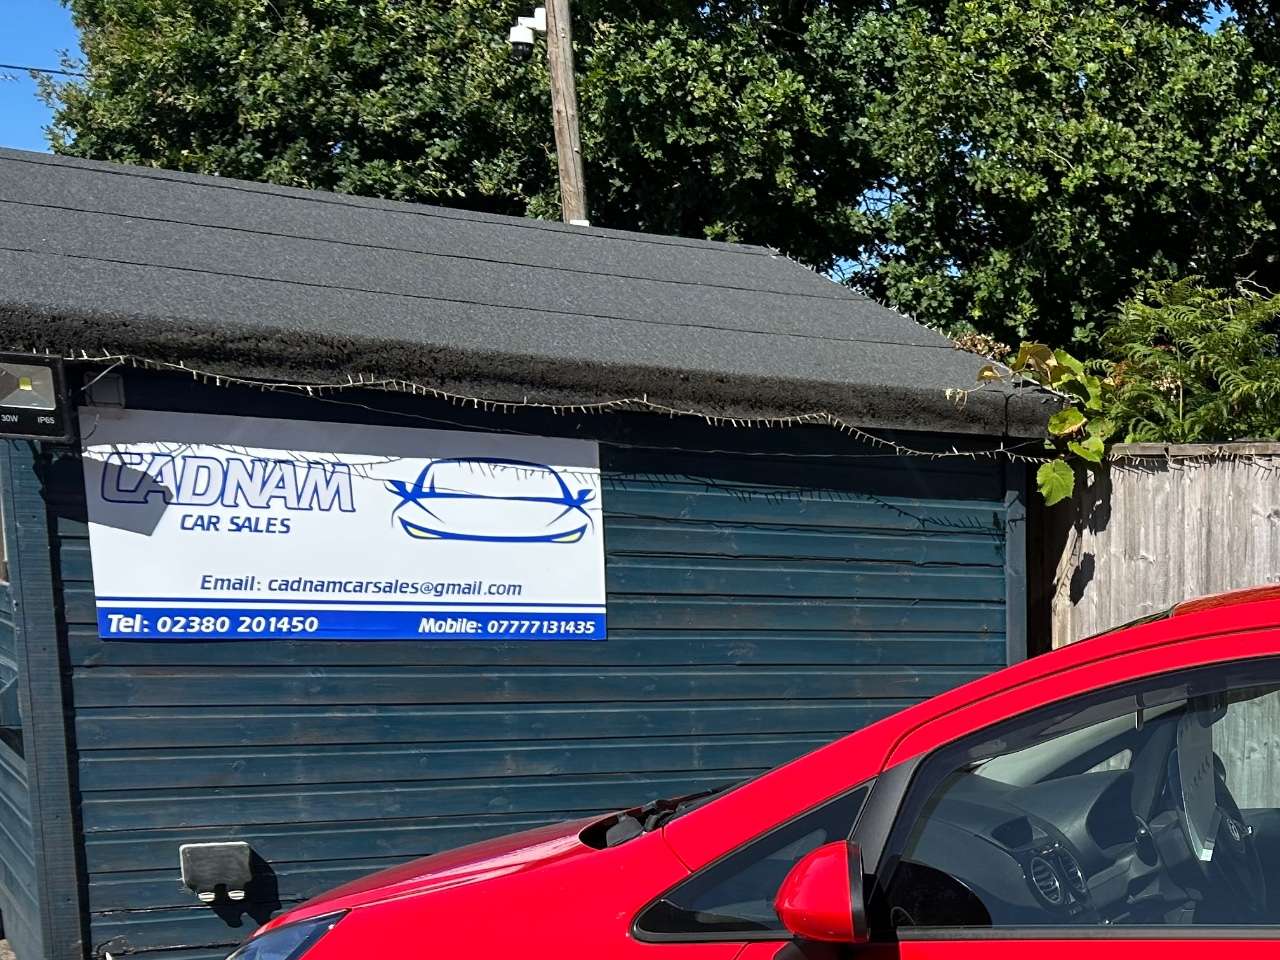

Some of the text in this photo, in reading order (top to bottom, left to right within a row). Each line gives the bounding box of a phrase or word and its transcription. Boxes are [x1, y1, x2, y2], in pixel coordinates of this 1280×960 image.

[101, 452, 356, 512] CADNAM
[180, 513, 291, 534] CAR SALES
[200, 574, 522, 597] Email: cadnamcarsales@gmail.com
[108, 613, 319, 633] Tel: 02380 201450
[418, 617, 596, 634] Mobile: 07777131435
